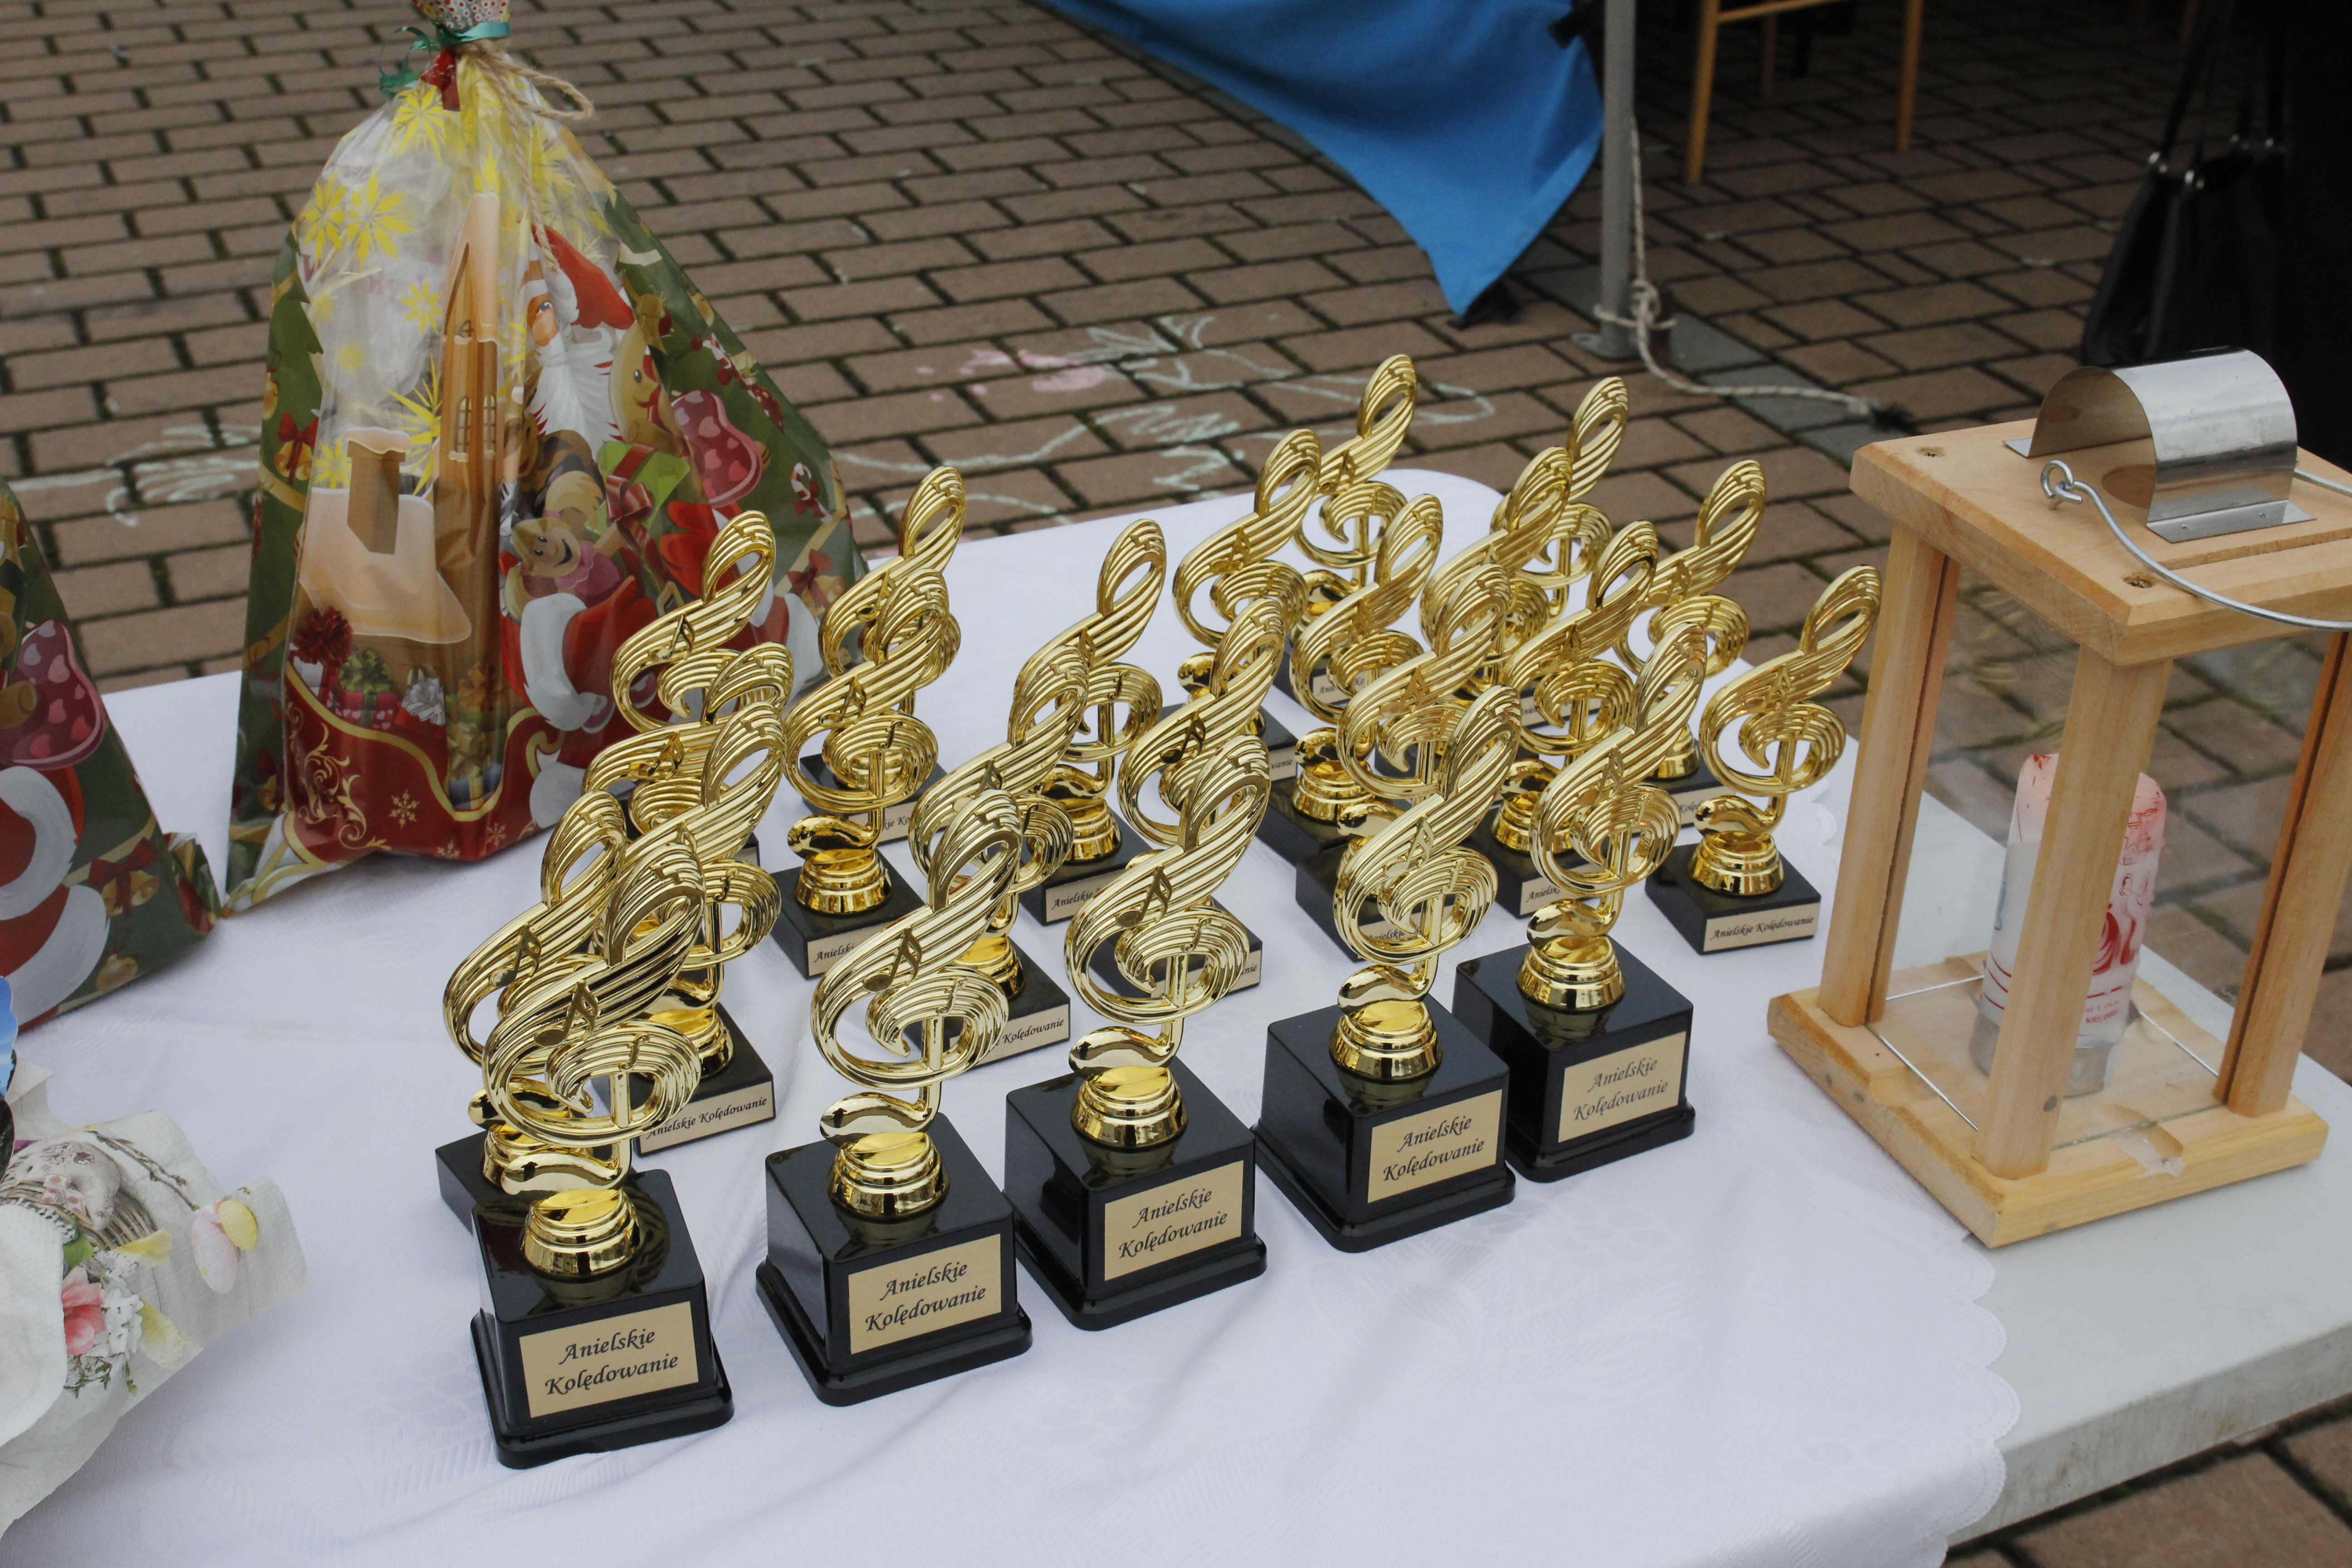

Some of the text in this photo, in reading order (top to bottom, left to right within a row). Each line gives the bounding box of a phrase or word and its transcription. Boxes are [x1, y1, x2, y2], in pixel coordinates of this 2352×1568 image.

[1710, 915, 1814, 940] Anielskie Kolędowanie
[813, 943, 855, 963] Anielski
[1003, 1018, 1064, 1044] Kolędowanie
[1587, 1057, 1657, 1093] Anielskie
[646, 1097, 767, 1139] Anielskie Kolędowanie
[1573, 1079, 1668, 1120] Kolędowanie
[1396, 1116, 1472, 1153] Anielskie
[1383, 1138, 1485, 1181] Kolędowanie
[1132, 1188, 1212, 1229] Anielskie
[1118, 1211, 1227, 1259] Kolędowanie
[879, 1261, 967, 1301] Anielskie
[865, 1285, 986, 1332] Kolędowanie
[559, 1328, 655, 1365] Anielskie
[544, 1353, 678, 1395] Kolędowanie
